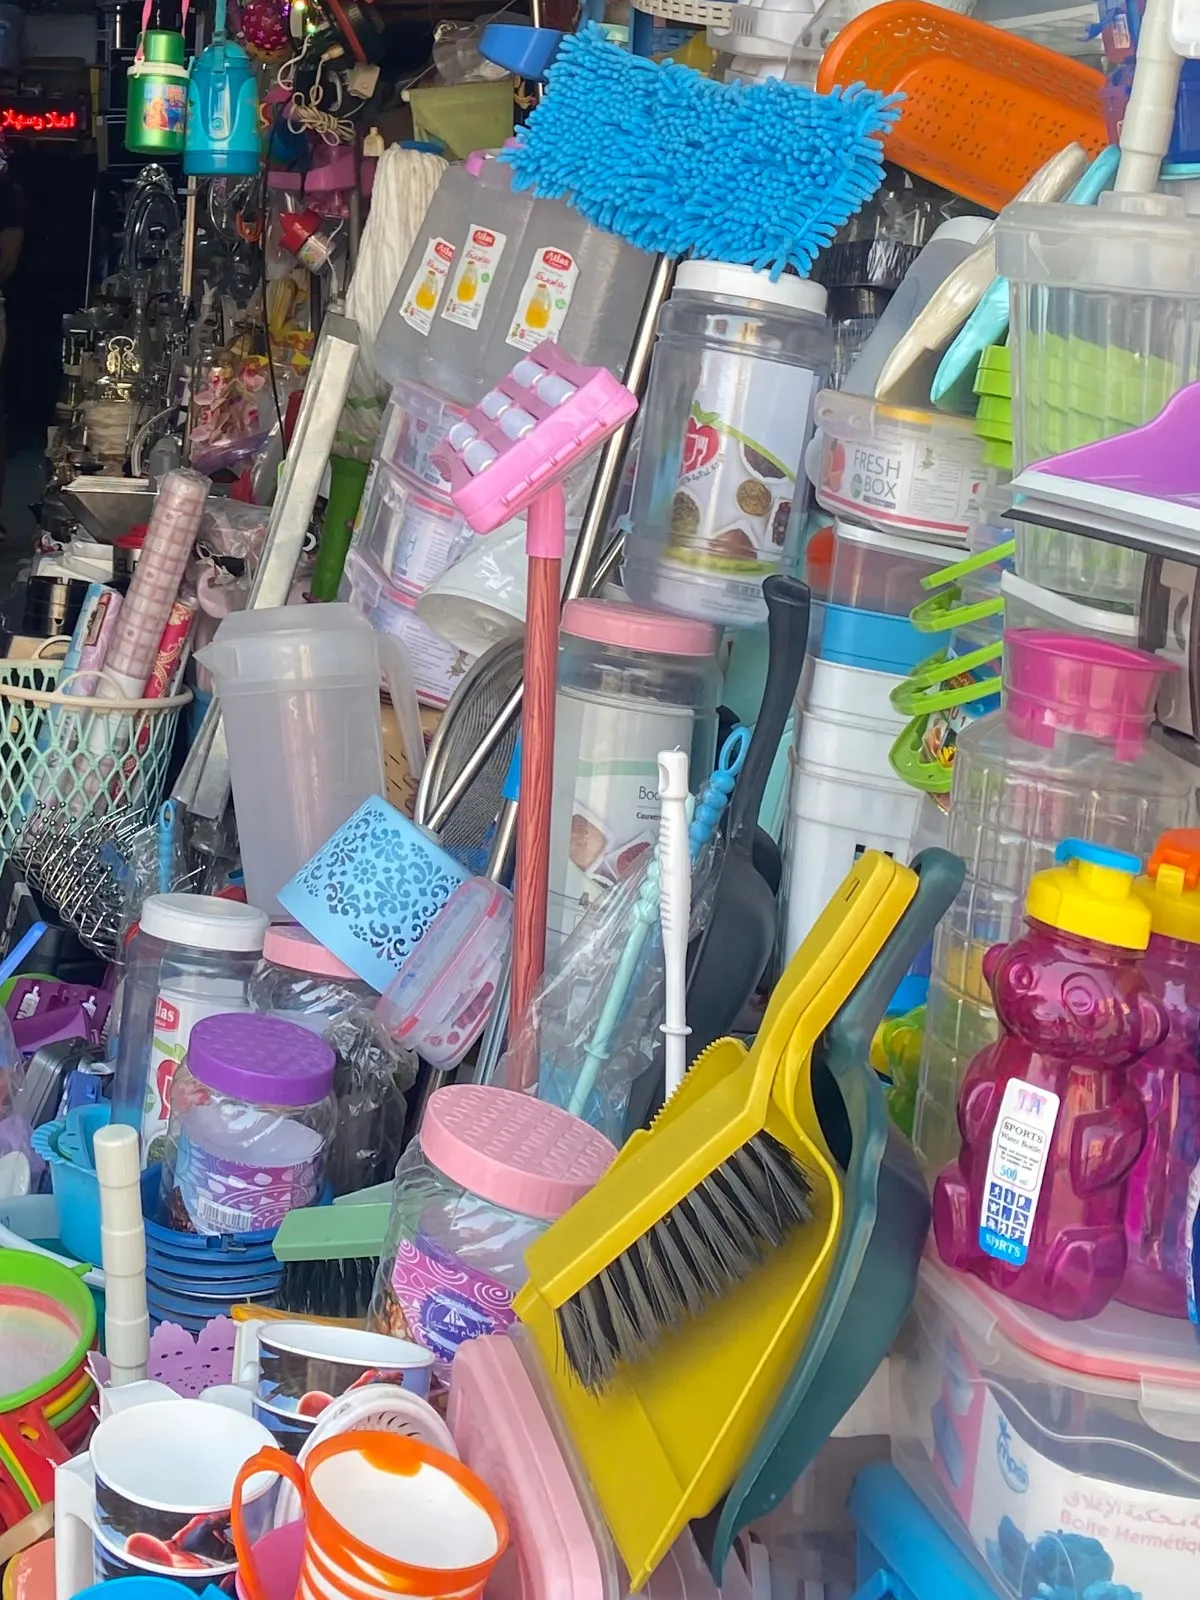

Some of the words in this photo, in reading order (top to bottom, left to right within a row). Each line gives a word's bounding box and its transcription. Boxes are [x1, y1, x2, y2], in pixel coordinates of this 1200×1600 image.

[545, 252, 569, 266] Atlas
[853, 449, 901, 480] FRESH
[864, 476, 898, 500] BOX
[1000, 1130, 1020, 1146] Water
[1003, 1120, 1044, 1144] SPORTS
[1000, 1165, 1019, 1183] 500
